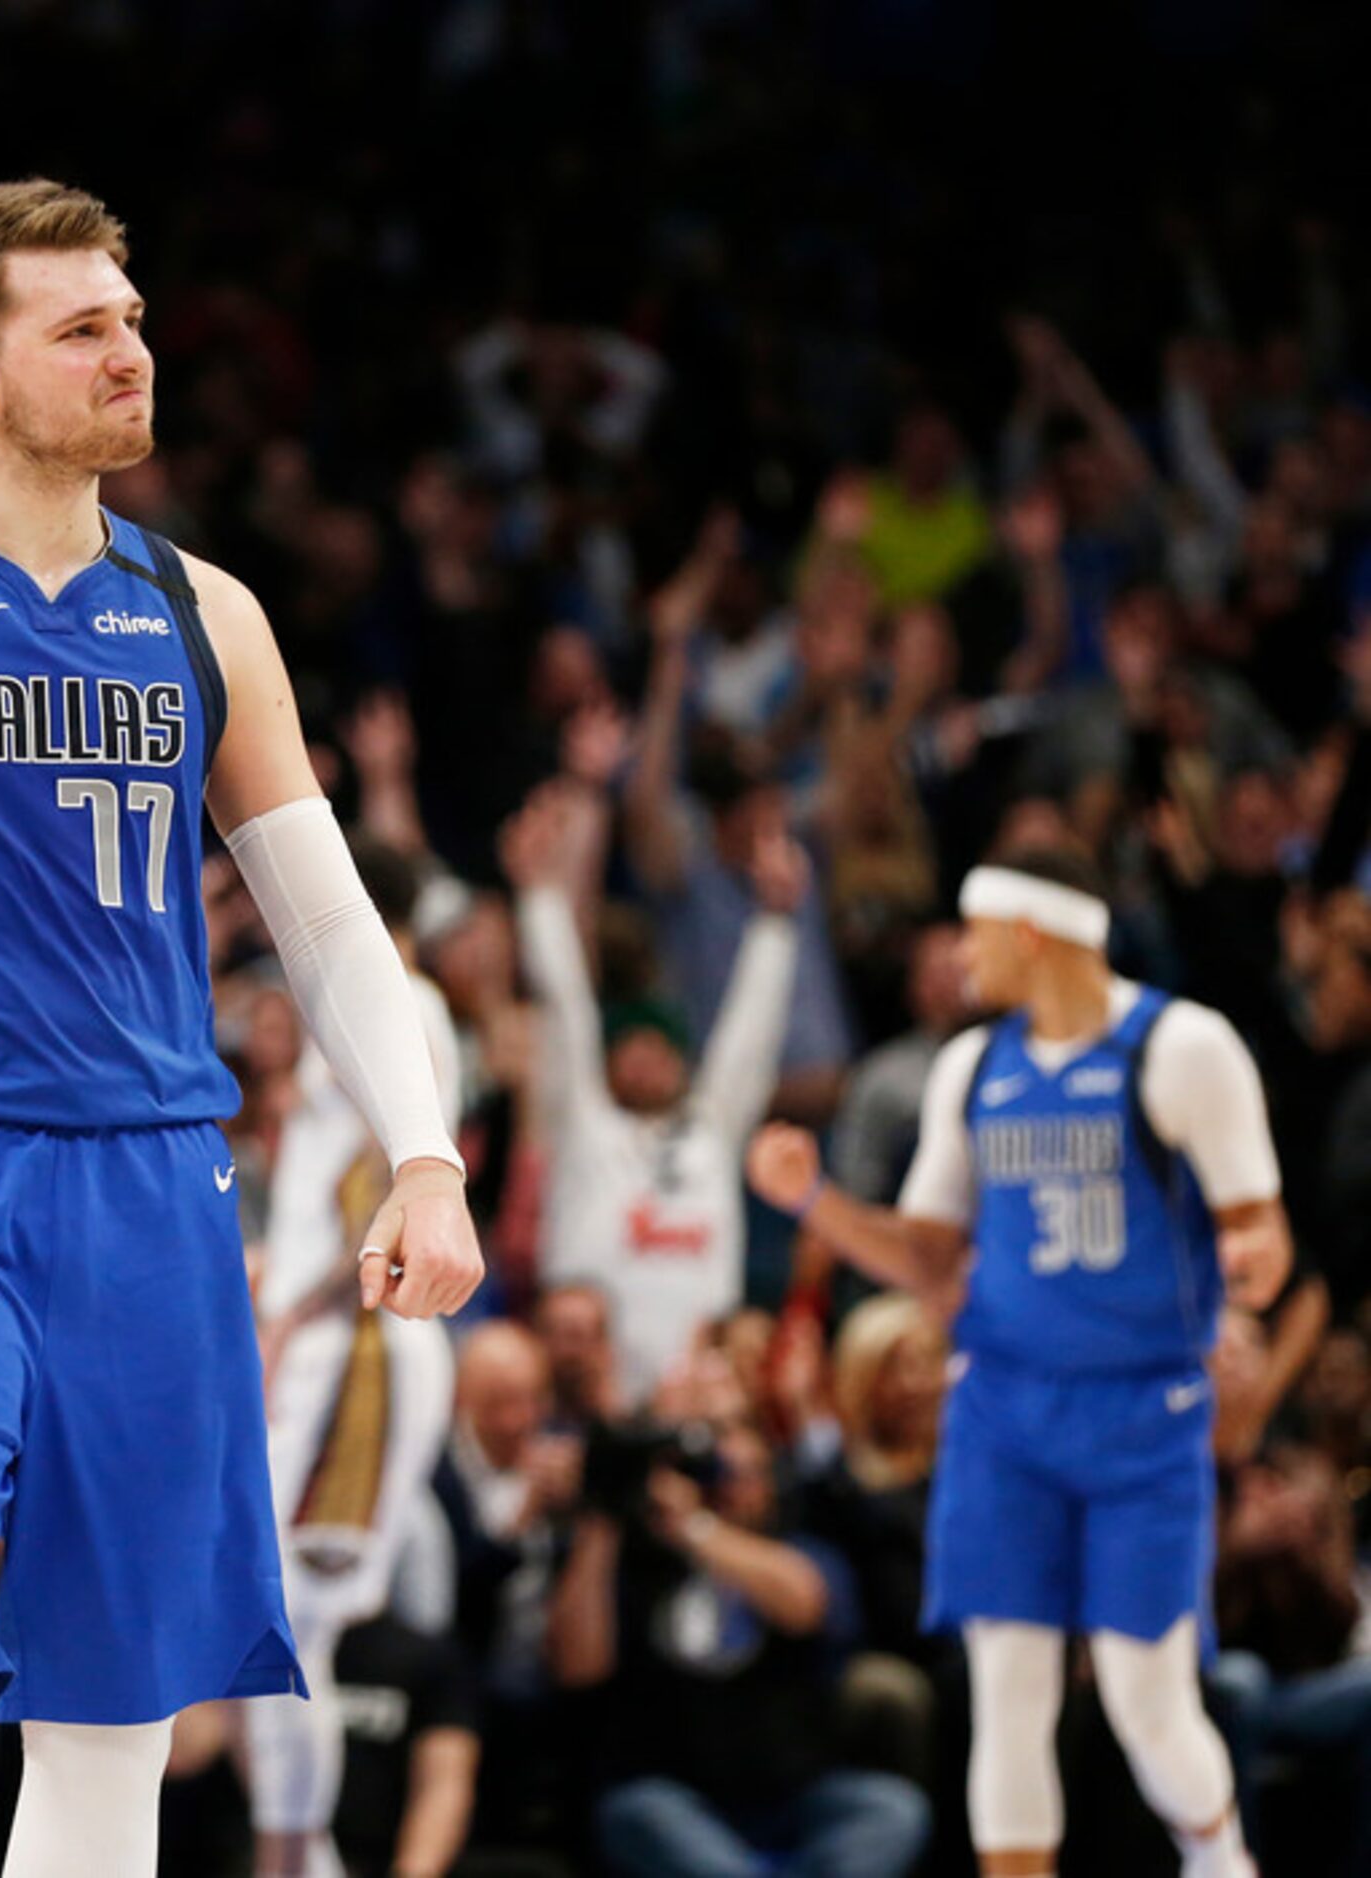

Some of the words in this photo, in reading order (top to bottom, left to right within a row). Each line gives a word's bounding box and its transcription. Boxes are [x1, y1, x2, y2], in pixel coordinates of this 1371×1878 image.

[94, 610, 170, 636] chime
[57, 778, 175, 913] 77
[981, 1117, 1123, 1184] DALLAS
[1032, 1184, 1126, 1274] 30
